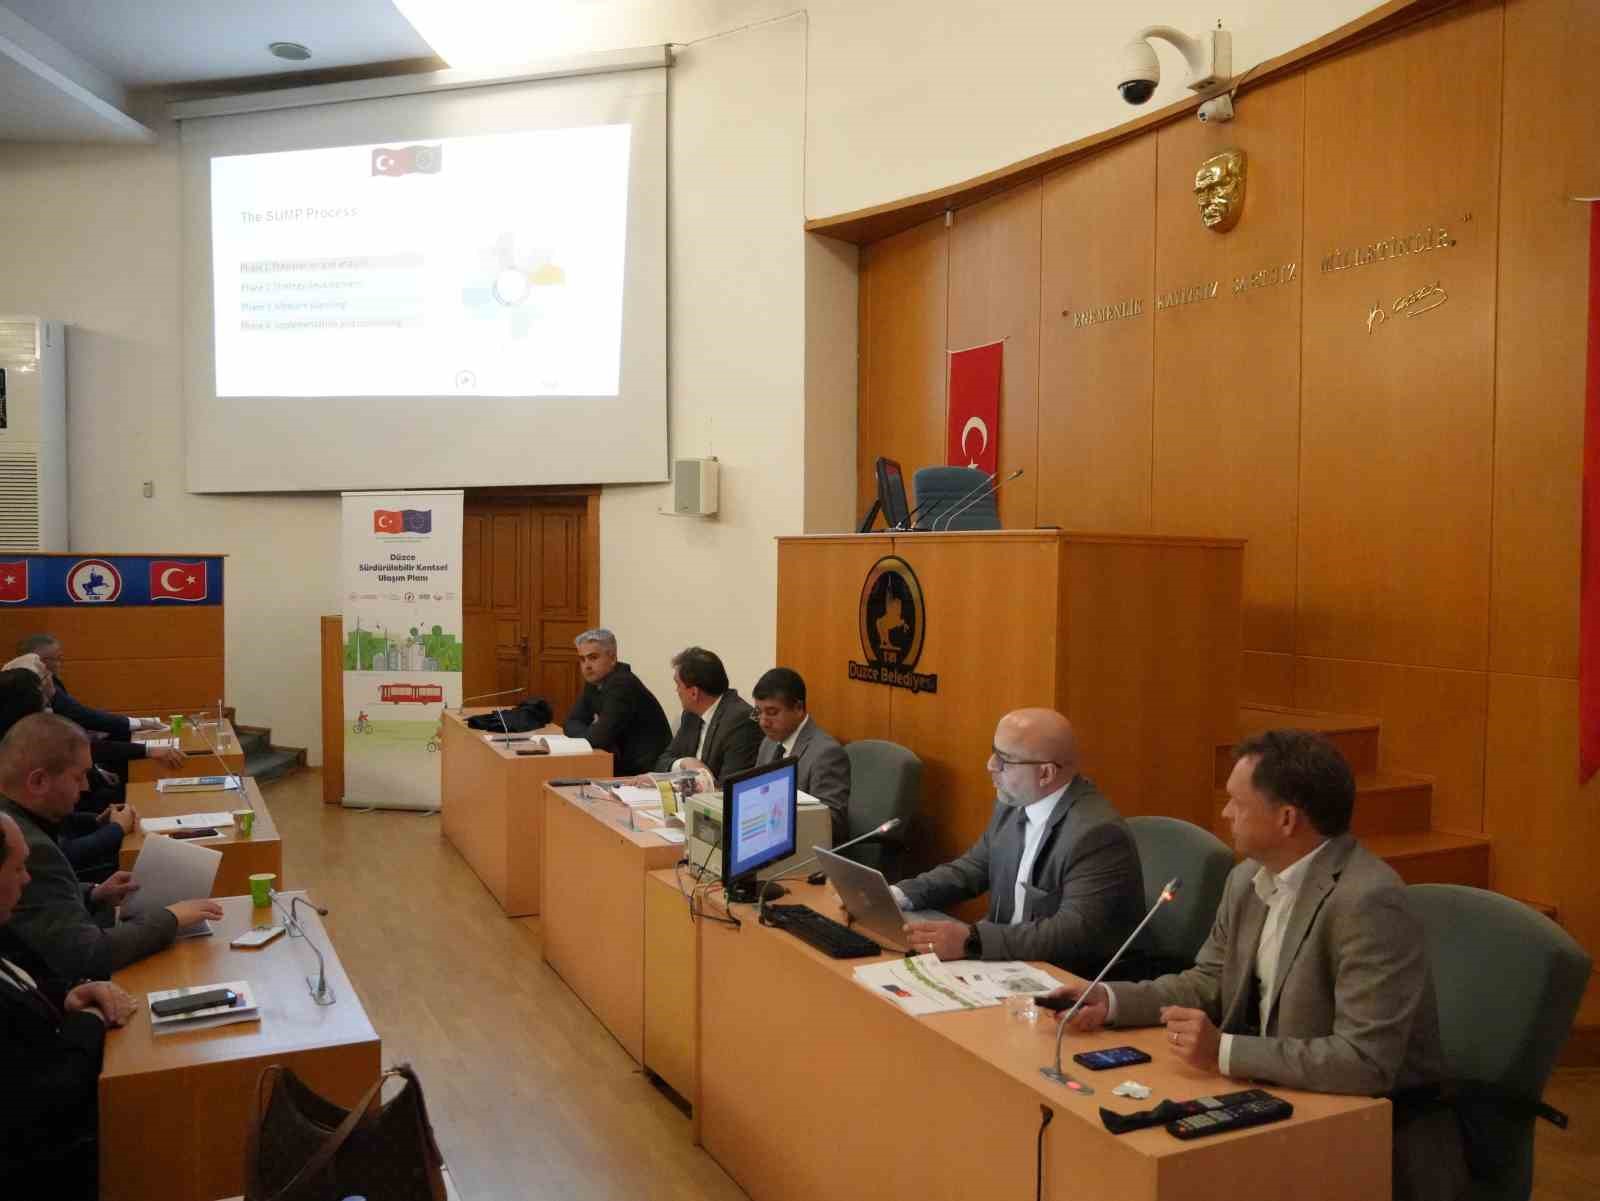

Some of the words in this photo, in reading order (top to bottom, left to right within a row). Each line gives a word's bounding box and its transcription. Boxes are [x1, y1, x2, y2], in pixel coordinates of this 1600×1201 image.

[240, 210, 263, 224] The
[306, 207, 359, 220] Process
[390, 553, 416, 561] Düzce
[416, 563, 448, 572] Kentsel
